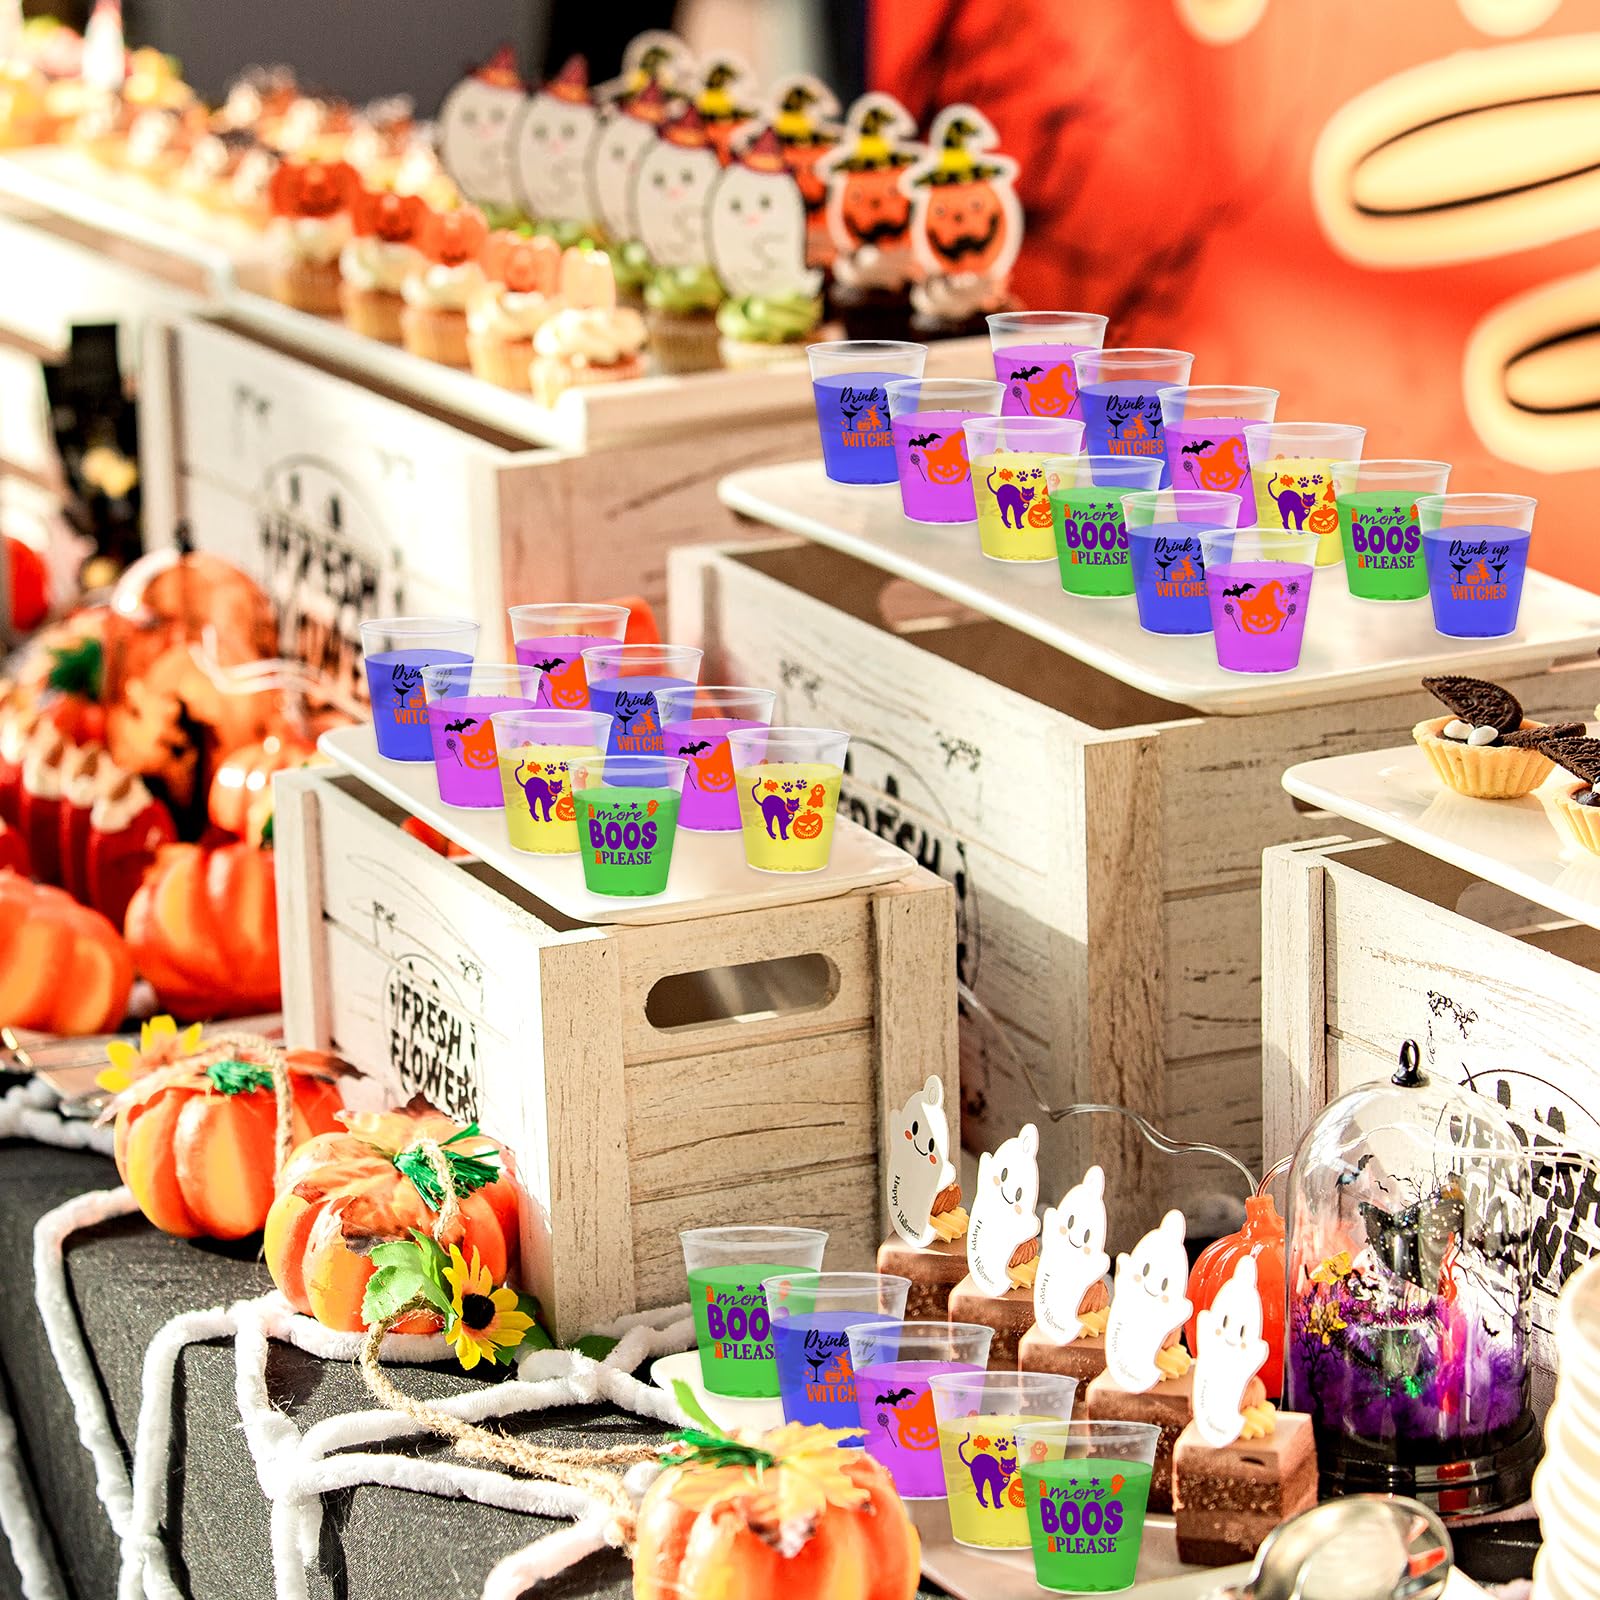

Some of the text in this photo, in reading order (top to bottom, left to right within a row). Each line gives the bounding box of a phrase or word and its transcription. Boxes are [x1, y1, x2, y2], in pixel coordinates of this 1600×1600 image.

[840, 386, 880, 404] Drink
[1106, 394, 1146, 411] Drink
[1107, 439, 1165, 456] WITCHES
[1072, 509, 1124, 521] more
[1359, 513, 1409, 526] more
[1064, 518, 1129, 551] BOOS
[1351, 522, 1421, 555] BOOS
[1154, 536, 1194, 554] Drink
[1448, 539, 1510, 562] Drink up
[1077, 550, 1128, 566] PLEASE
[1364, 554, 1416, 570] PLEASE
[1450, 583, 1508, 601] WITCHES
[391, 663, 429, 681] Drin
[615, 690, 655, 708] Drink
[393, 708, 428, 725] WITC
[596, 809, 646, 821] more
[588, 818, 658, 851] BOOS
[600, 850, 653, 866] PLEASE
[401, 982, 462, 1063] FRESH
[707, 1303, 771, 1343] BOO
[803, 1328, 850, 1350] Drink
[722, 1341, 776, 1361] PLEAS
[805, 1383, 858, 1403] WITCH
[1049, 1486, 1110, 1501] more
[1039, 1497, 1124, 1537] BOOS
[1054, 1535, 1118, 1554] PLEASE
